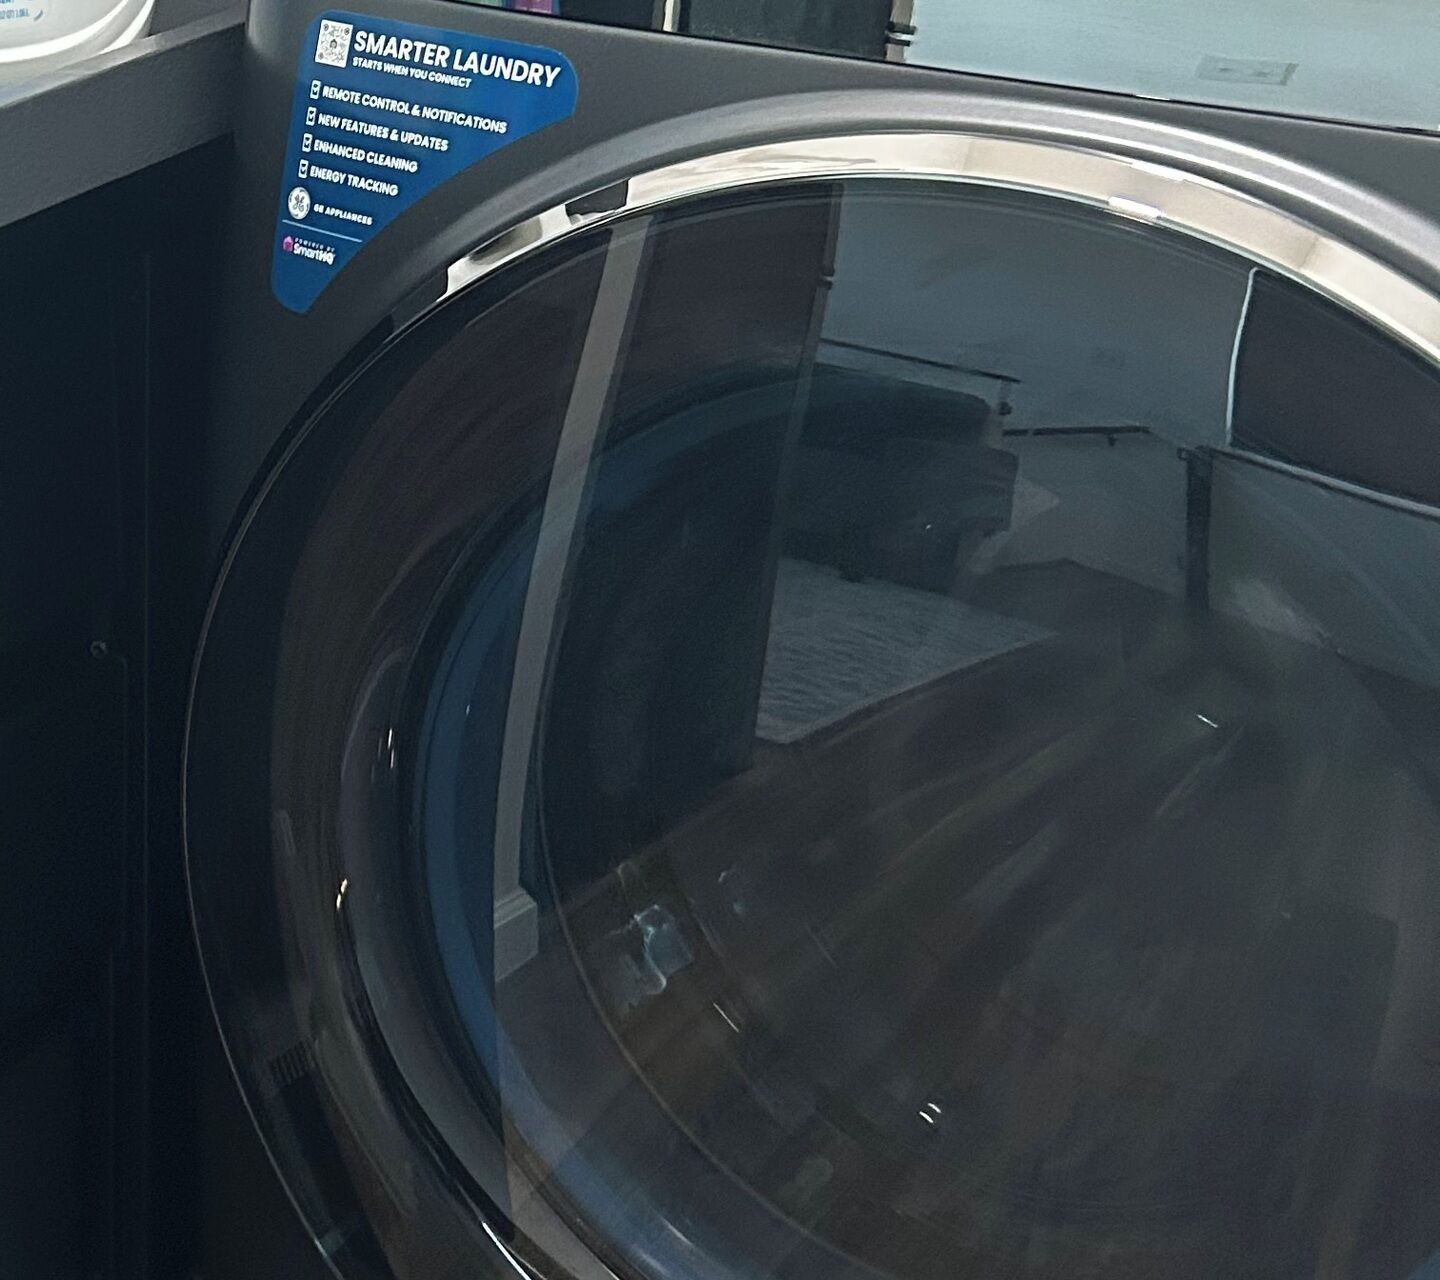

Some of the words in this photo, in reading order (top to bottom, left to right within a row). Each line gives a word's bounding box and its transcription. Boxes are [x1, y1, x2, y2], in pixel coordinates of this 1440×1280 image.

[352, 57, 383, 71] STARTS
[383, 62, 409, 77] WHEN
[409, 67, 428, 80] YOU
[428, 70, 472, 88] CONNECT
[354, 31, 450, 68] SMARTER
[453, 49, 561, 88] LAUNDRY
[322, 85, 361, 104] REMOTE
[362, 94, 410, 115] CONTROL
[411, 105, 420, 117] &
[422, 107, 508, 134] NOTIFICATIONS
[318, 113, 340, 129] NEW
[340, 119, 389, 140] FEATURES
[390, 129, 399, 141] &
[401, 131, 449, 151] UPDATES
[313, 139, 365, 161] ENHANCED
[366, 151, 418, 173] CLEANING
[310, 165, 347, 184] ENERGY
[347, 174, 399, 196] TRACKING
[325, 207, 373, 226] APPLIANCES
